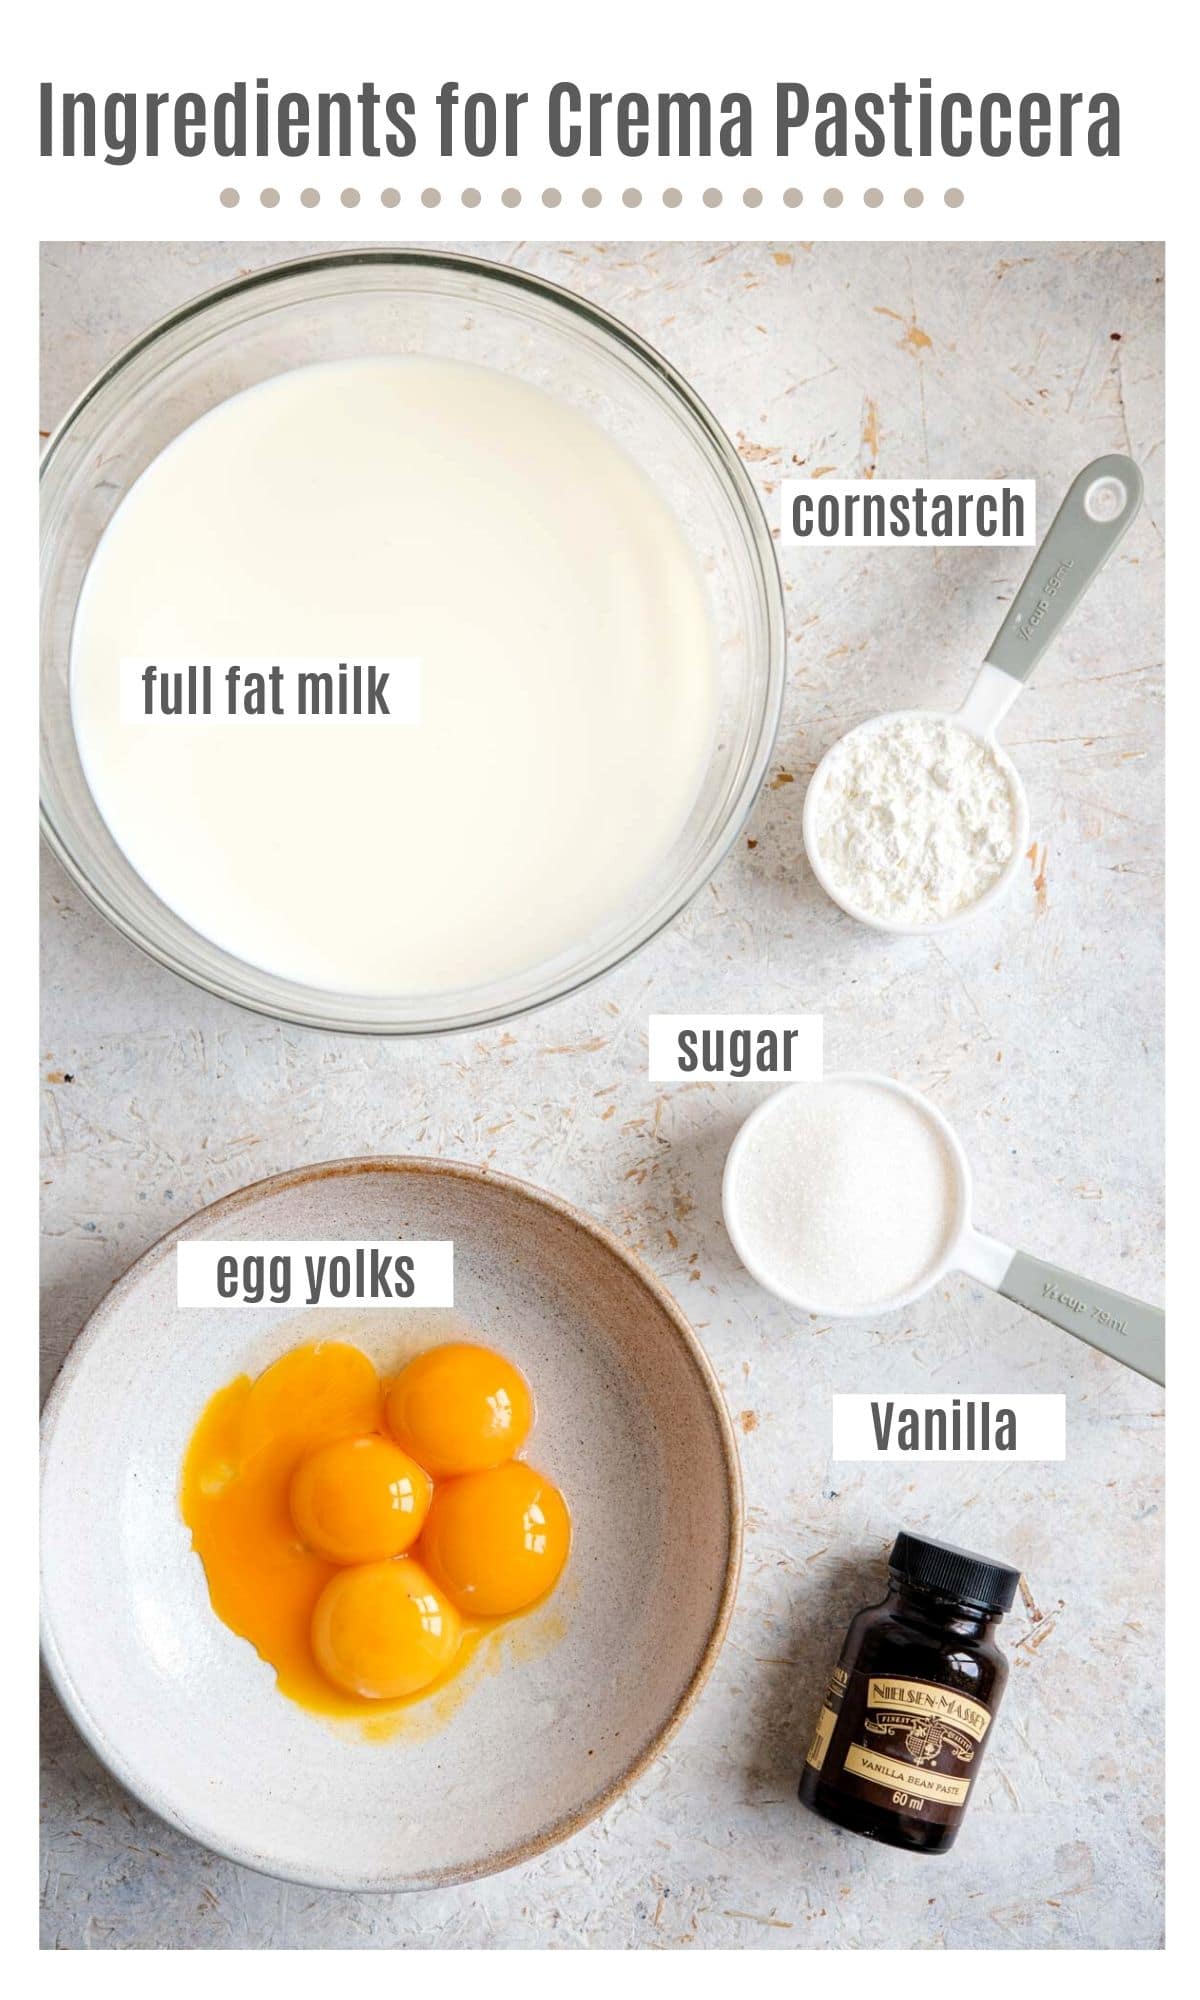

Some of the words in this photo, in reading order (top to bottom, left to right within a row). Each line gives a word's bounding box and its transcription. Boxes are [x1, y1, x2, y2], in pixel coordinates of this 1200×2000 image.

[1029, 600, 1048, 626] cup
[1058, 1294, 1087, 1313] cup
[861, 1758, 905, 1781] VANILLA
[907, 1775, 934, 1789] BEAN
[936, 1785, 959, 1796] PASTE
[892, 1791, 908, 1806] 60
[909, 1799, 924, 1811] ml
